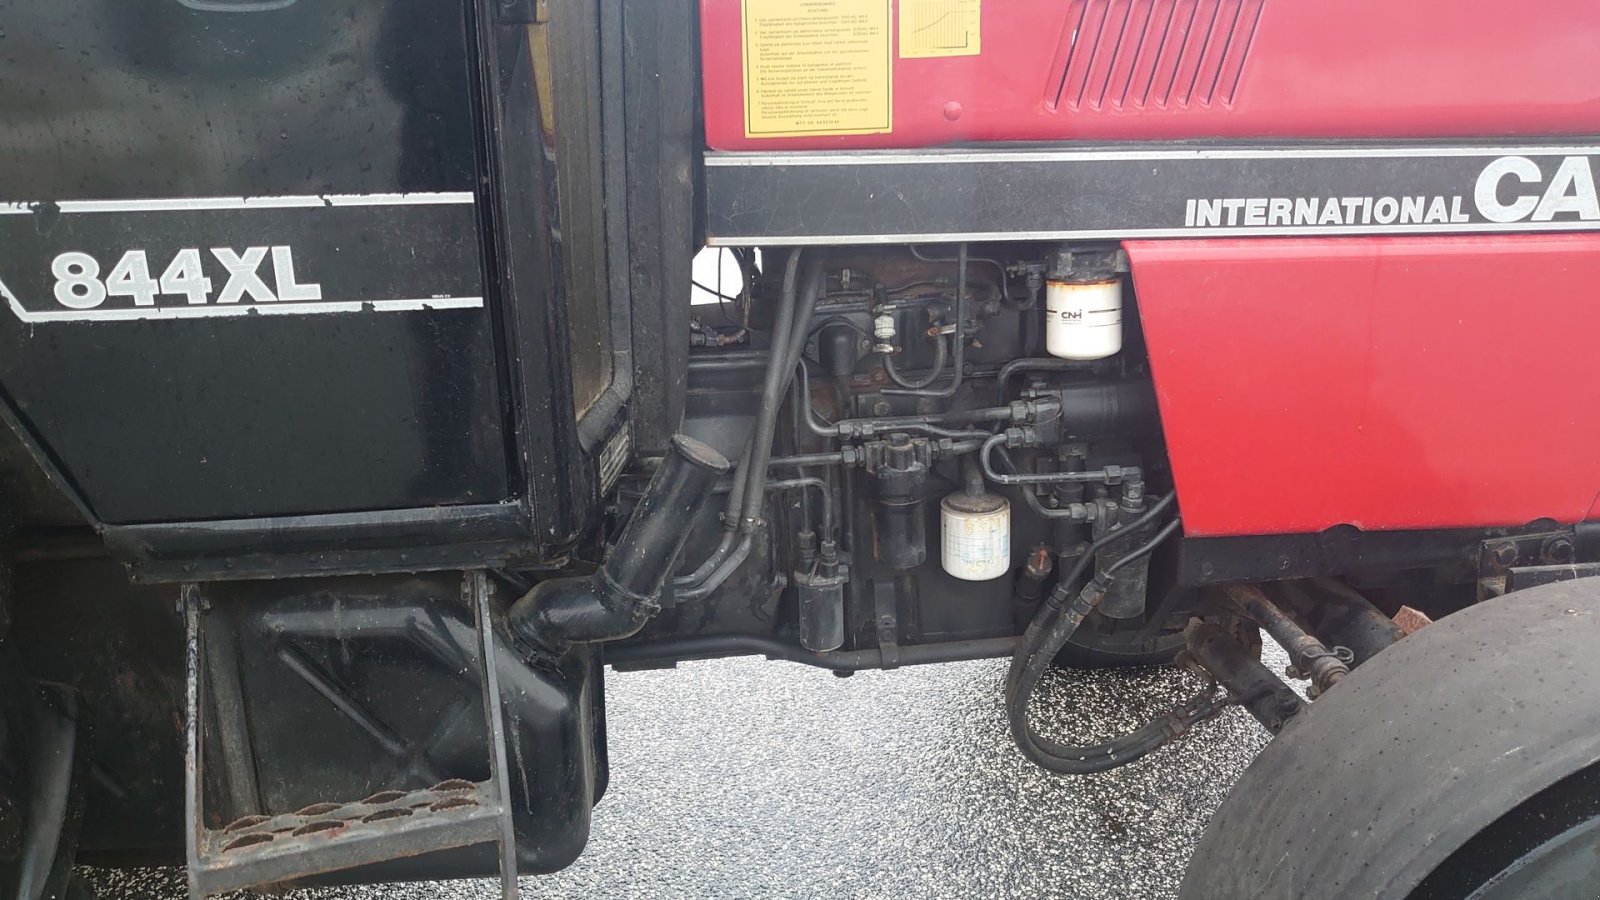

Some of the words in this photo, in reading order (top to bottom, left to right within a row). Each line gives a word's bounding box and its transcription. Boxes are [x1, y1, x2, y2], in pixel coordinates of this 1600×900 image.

[1184, 196, 1470, 227] INTERNATIONAL
[1474, 155, 1600, 223] CA
[51, 245, 322, 309] 844XL
